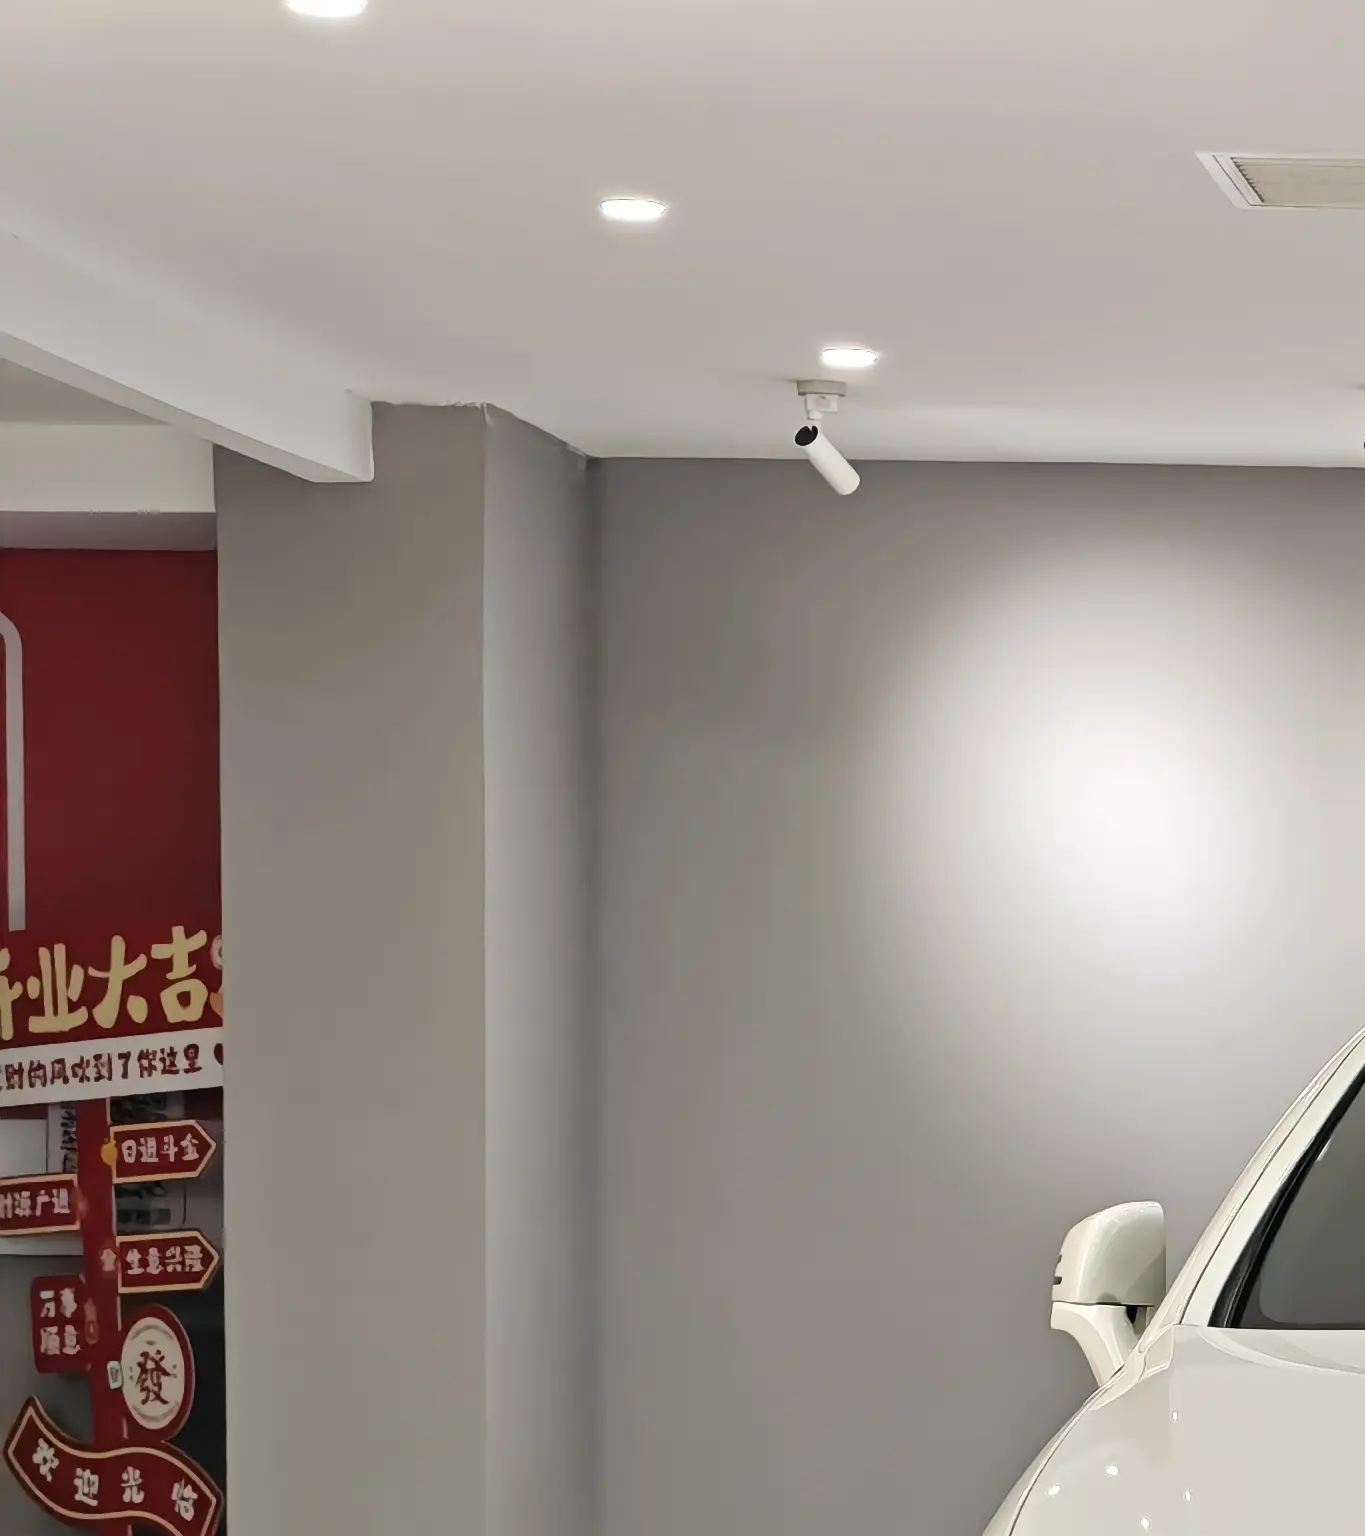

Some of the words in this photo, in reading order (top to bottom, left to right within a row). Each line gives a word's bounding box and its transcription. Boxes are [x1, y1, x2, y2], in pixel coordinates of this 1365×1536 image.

[125, 1244, 203, 1275] 生意兴隆
[32, 1437, 199, 1522] 欢迎光临
